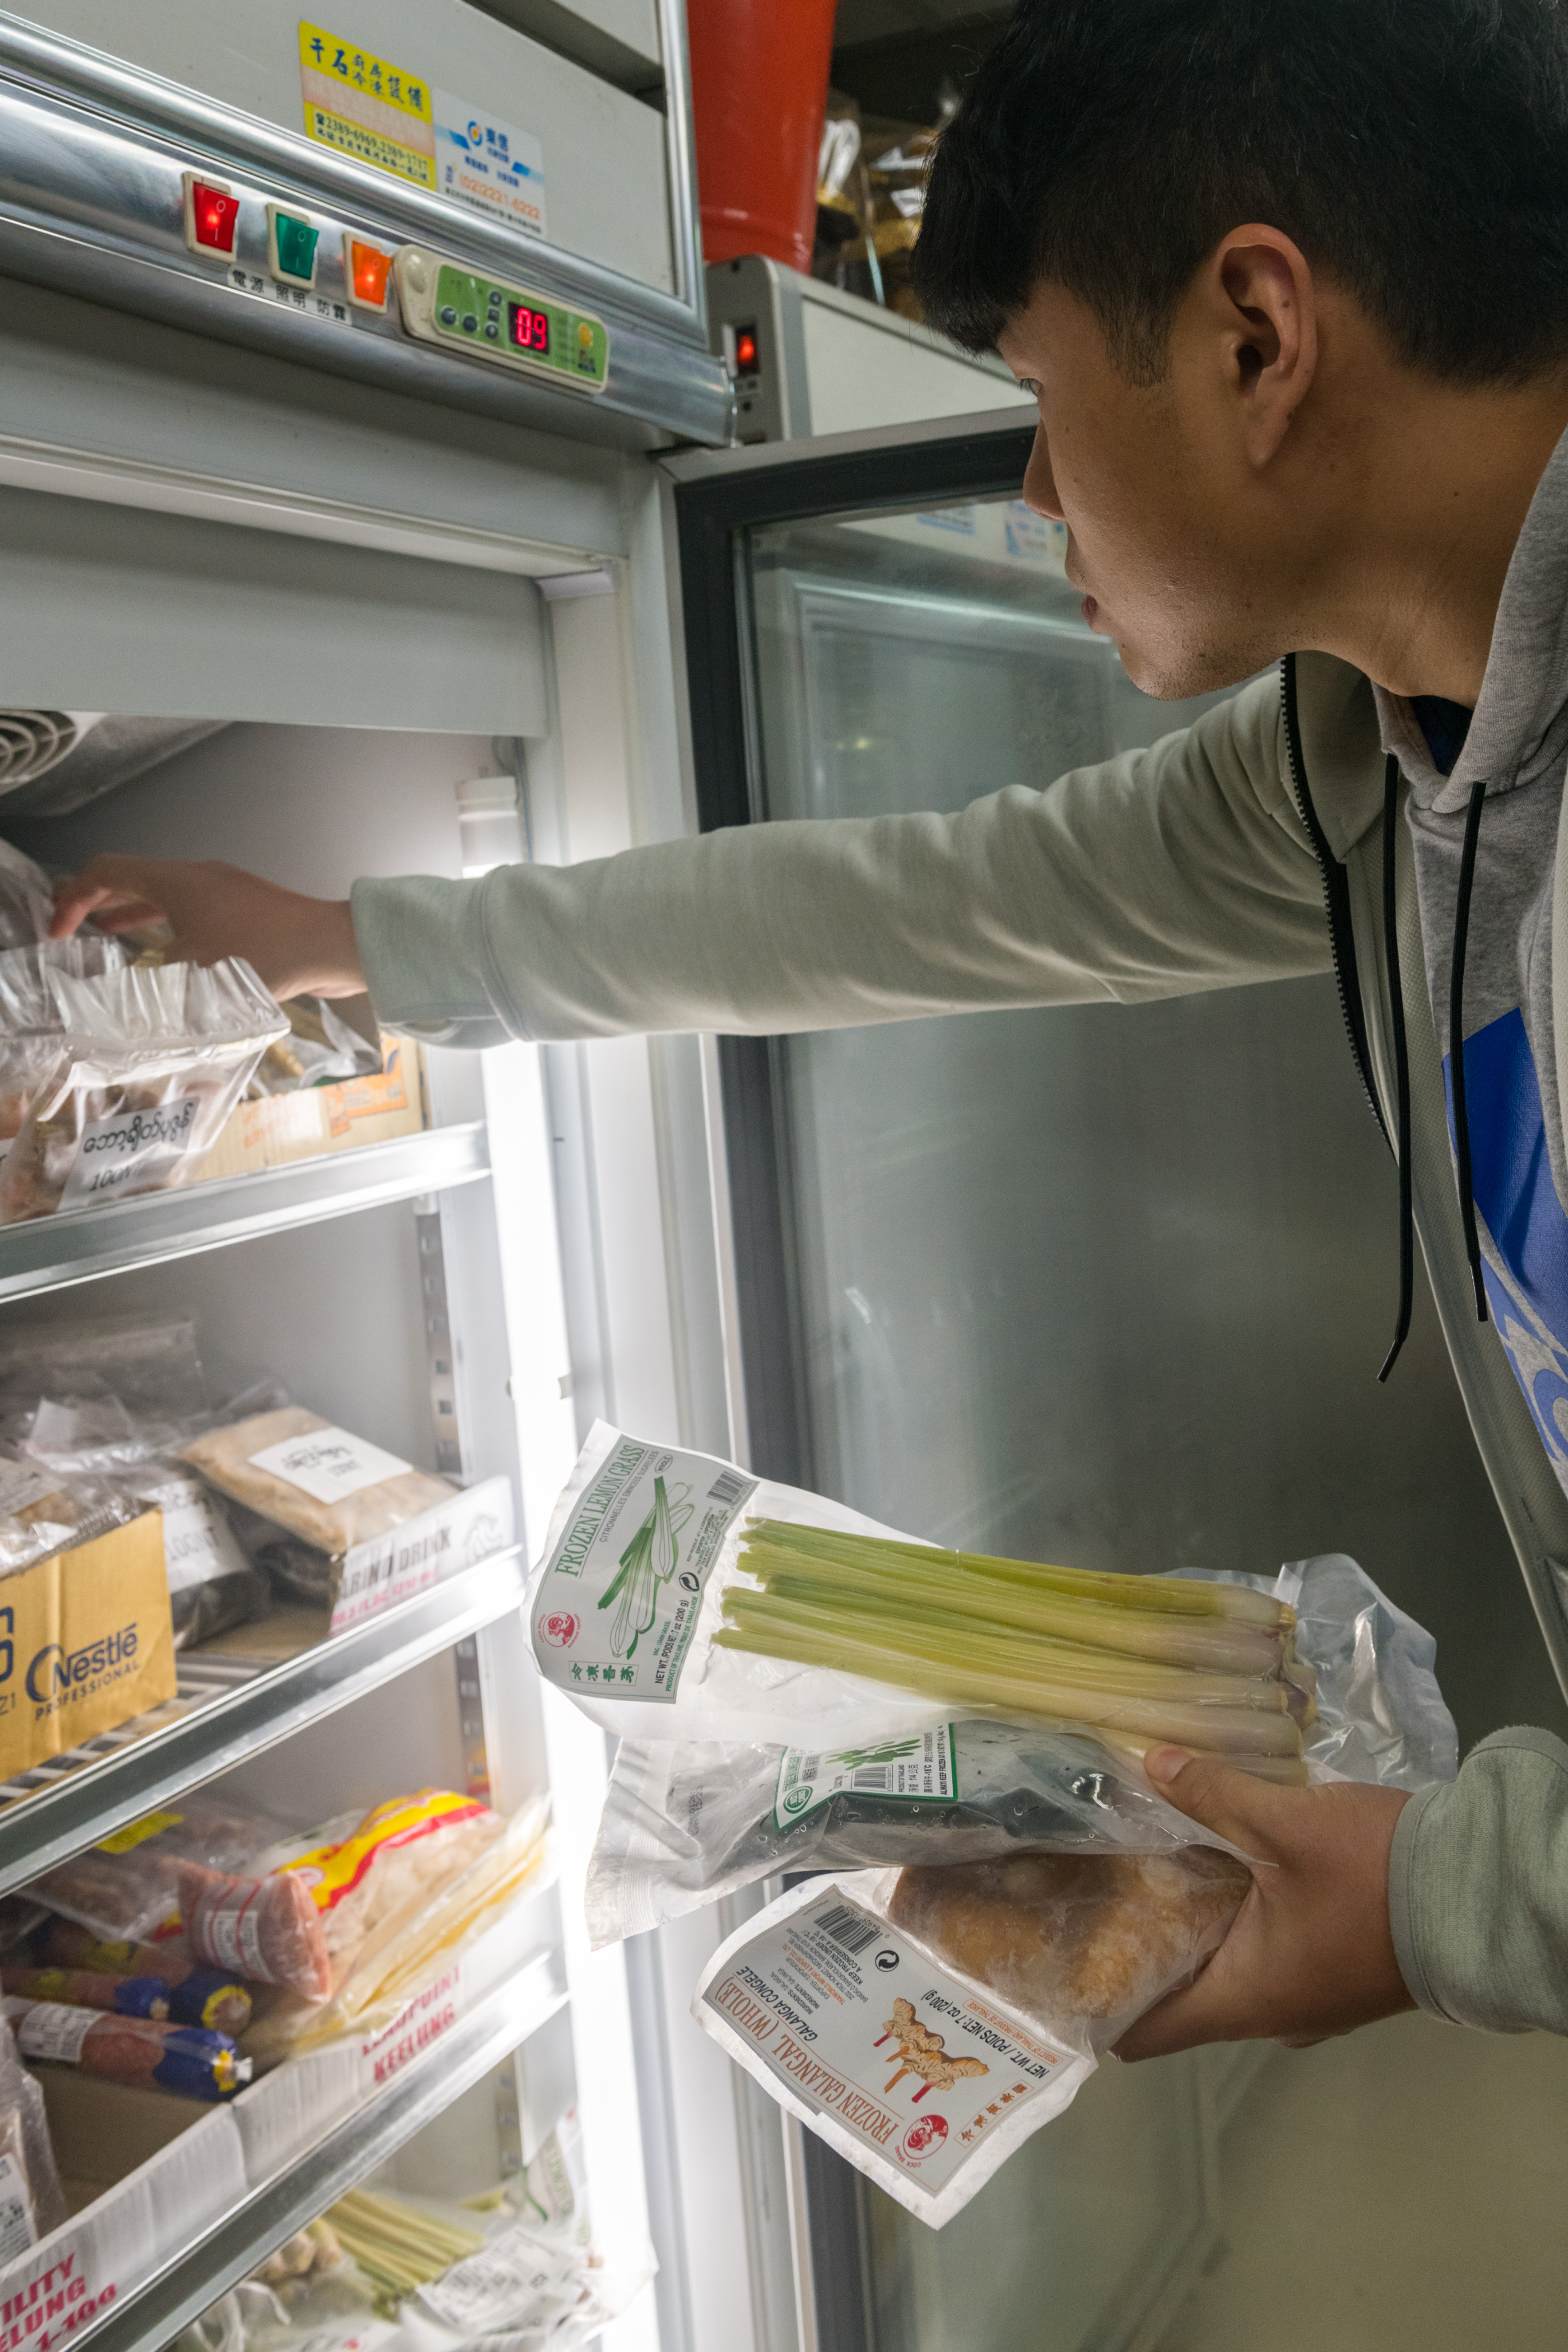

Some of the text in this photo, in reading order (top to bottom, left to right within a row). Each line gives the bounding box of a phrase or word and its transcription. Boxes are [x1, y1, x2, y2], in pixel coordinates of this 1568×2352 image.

[232, 268, 265, 294] 電源
[275, 285, 307, 308] 照明
[554, 1444, 645, 1577] FROZEN LEMON GRASS
[599, 1497, 627, 1542] CITRONNELLES
[656, 1634, 665, 1646] LEMON
[654, 1669, 665, 1685] NET
[665, 1668, 675, 1692] PRODUCT
[35, 1660, 141, 1722] PROFESSIONAL
[815, 1940, 833, 1956] UNDER
[829, 1942, 858, 1969] CONSERVER
[829, 1952, 851, 1973] FROZEN
[776, 1966, 821, 2010] INGREDIENTS: GALANGA
[810, 1969, 826, 1985] IMPORT
[848, 1969, 863, 1985] KEEP
[768, 1970, 814, 2015] INGREDIENTS: GALANGAL
[809, 1979, 830, 2000] EXPORTER
[844, 1989, 855, 2000] 2532
[920, 1986, 938, 2005] g)
[737, 1965, 819, 2042] GALANGA CONGELE
[929, 1992, 953, 2015] (200
[946, 2005, 961, 2019] oz
[962, 2015, 986, 2037] NET:
[979, 2027, 1011, 2055] POIDS
[717, 1978, 900, 2145] FROZEN GALANGAL (WHOLE)
[1010, 2049, 1031, 2069] WT.
[1025, 2058, 1049, 2081] NET
